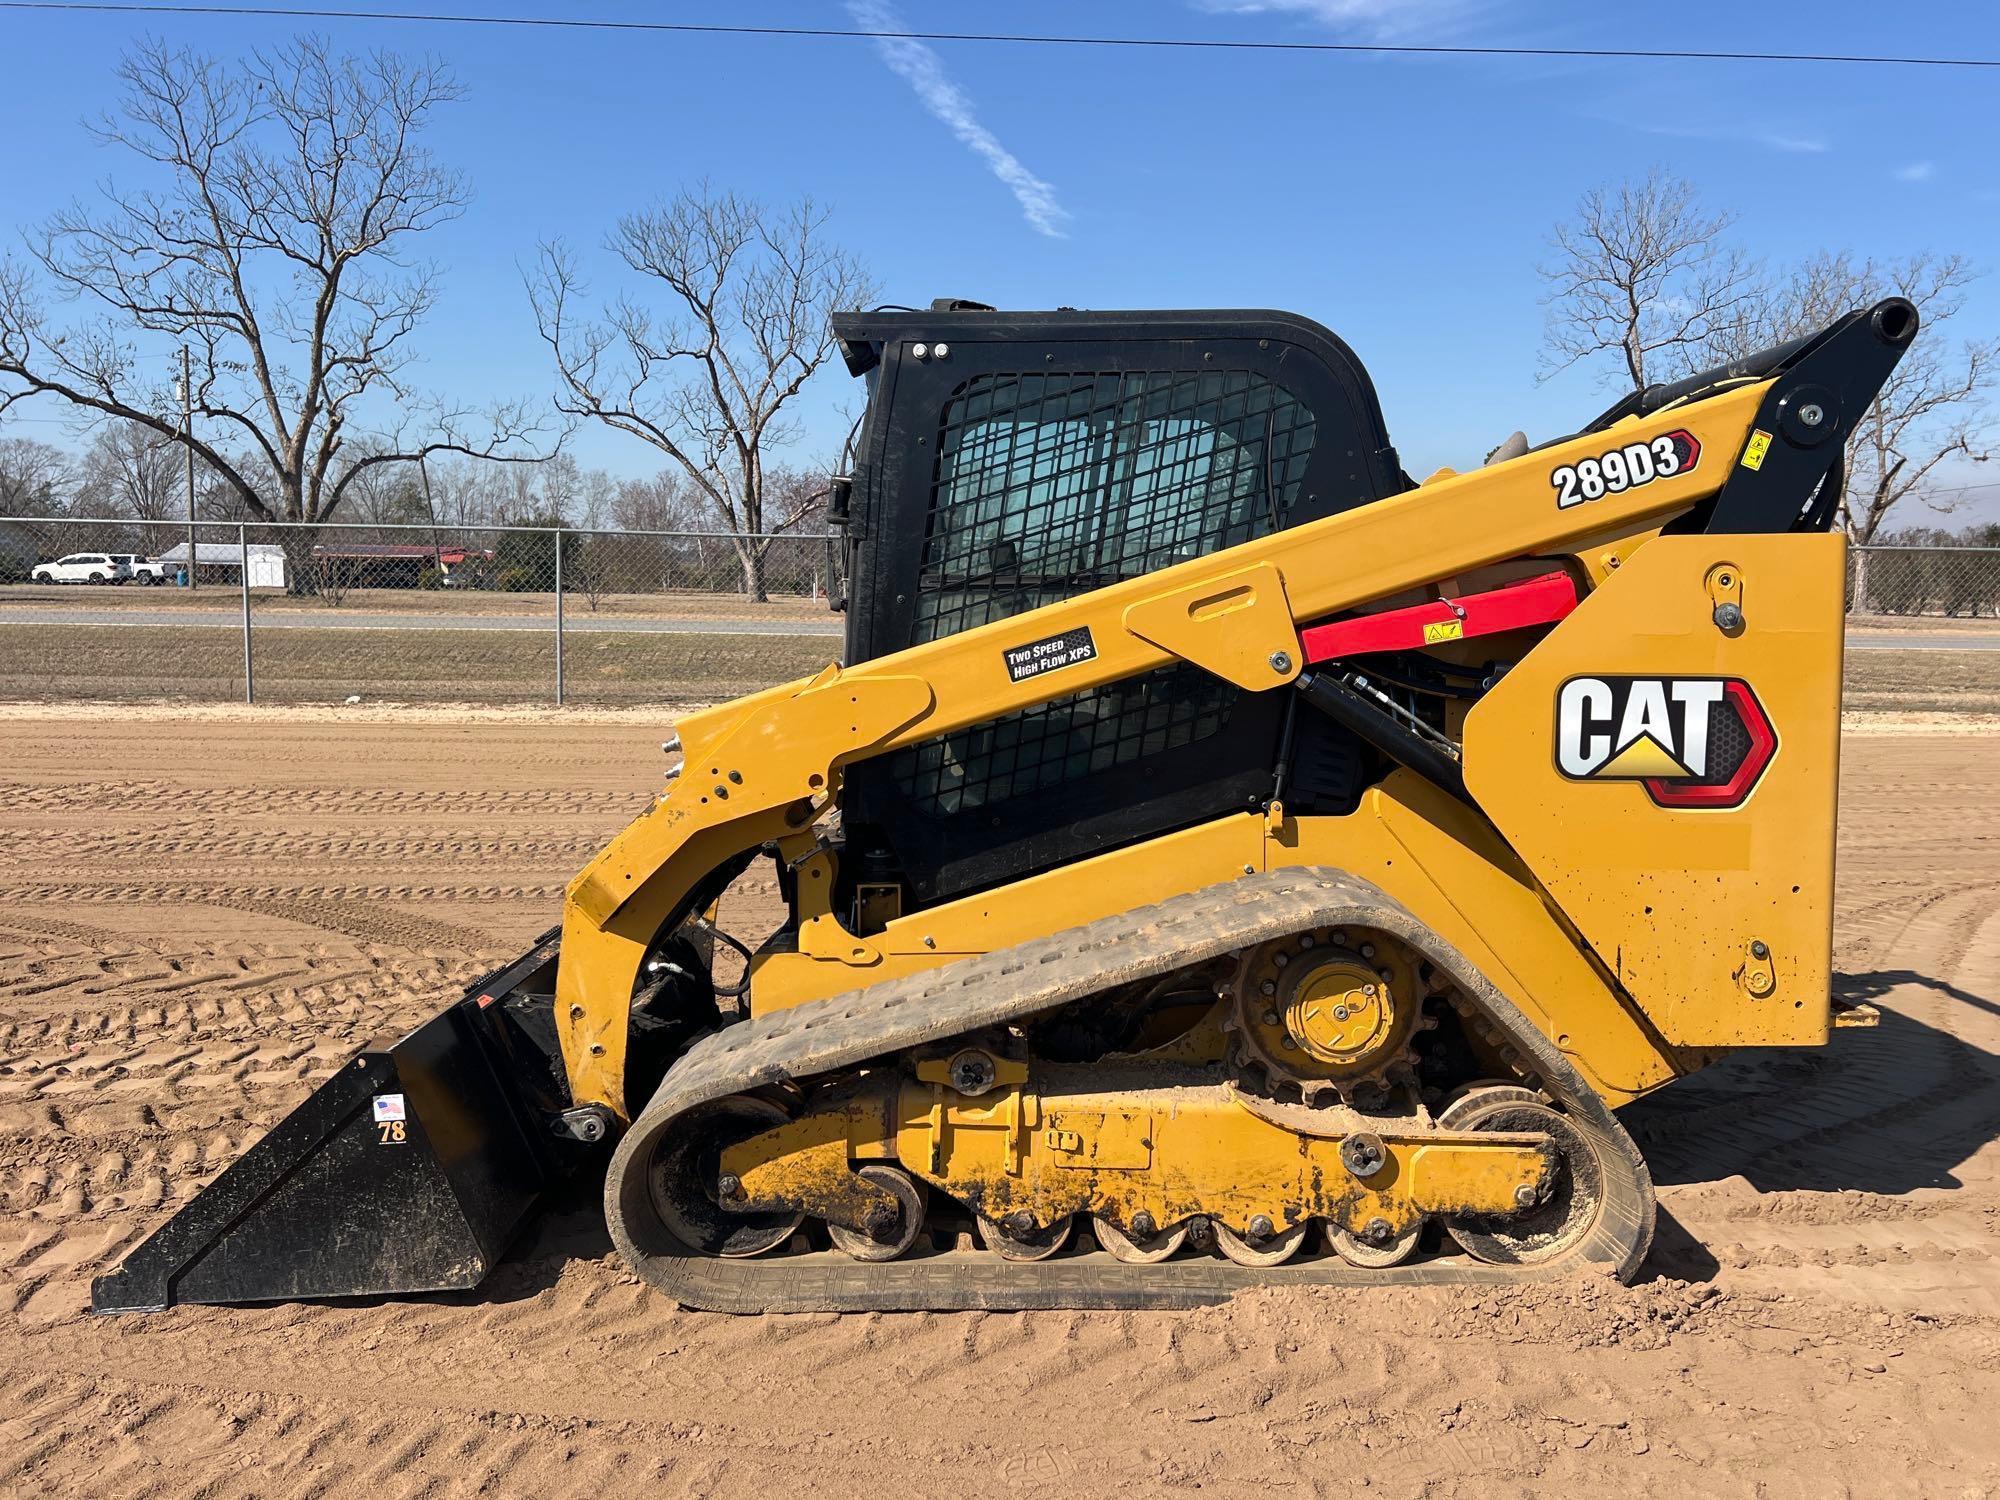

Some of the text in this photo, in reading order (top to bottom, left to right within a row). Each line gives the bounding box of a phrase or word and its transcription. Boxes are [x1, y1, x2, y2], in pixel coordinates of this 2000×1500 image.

[1553, 436, 1679, 507] 289D3
[1069, 645, 1091, 661] XPS
[1559, 678, 1724, 777] CAT
